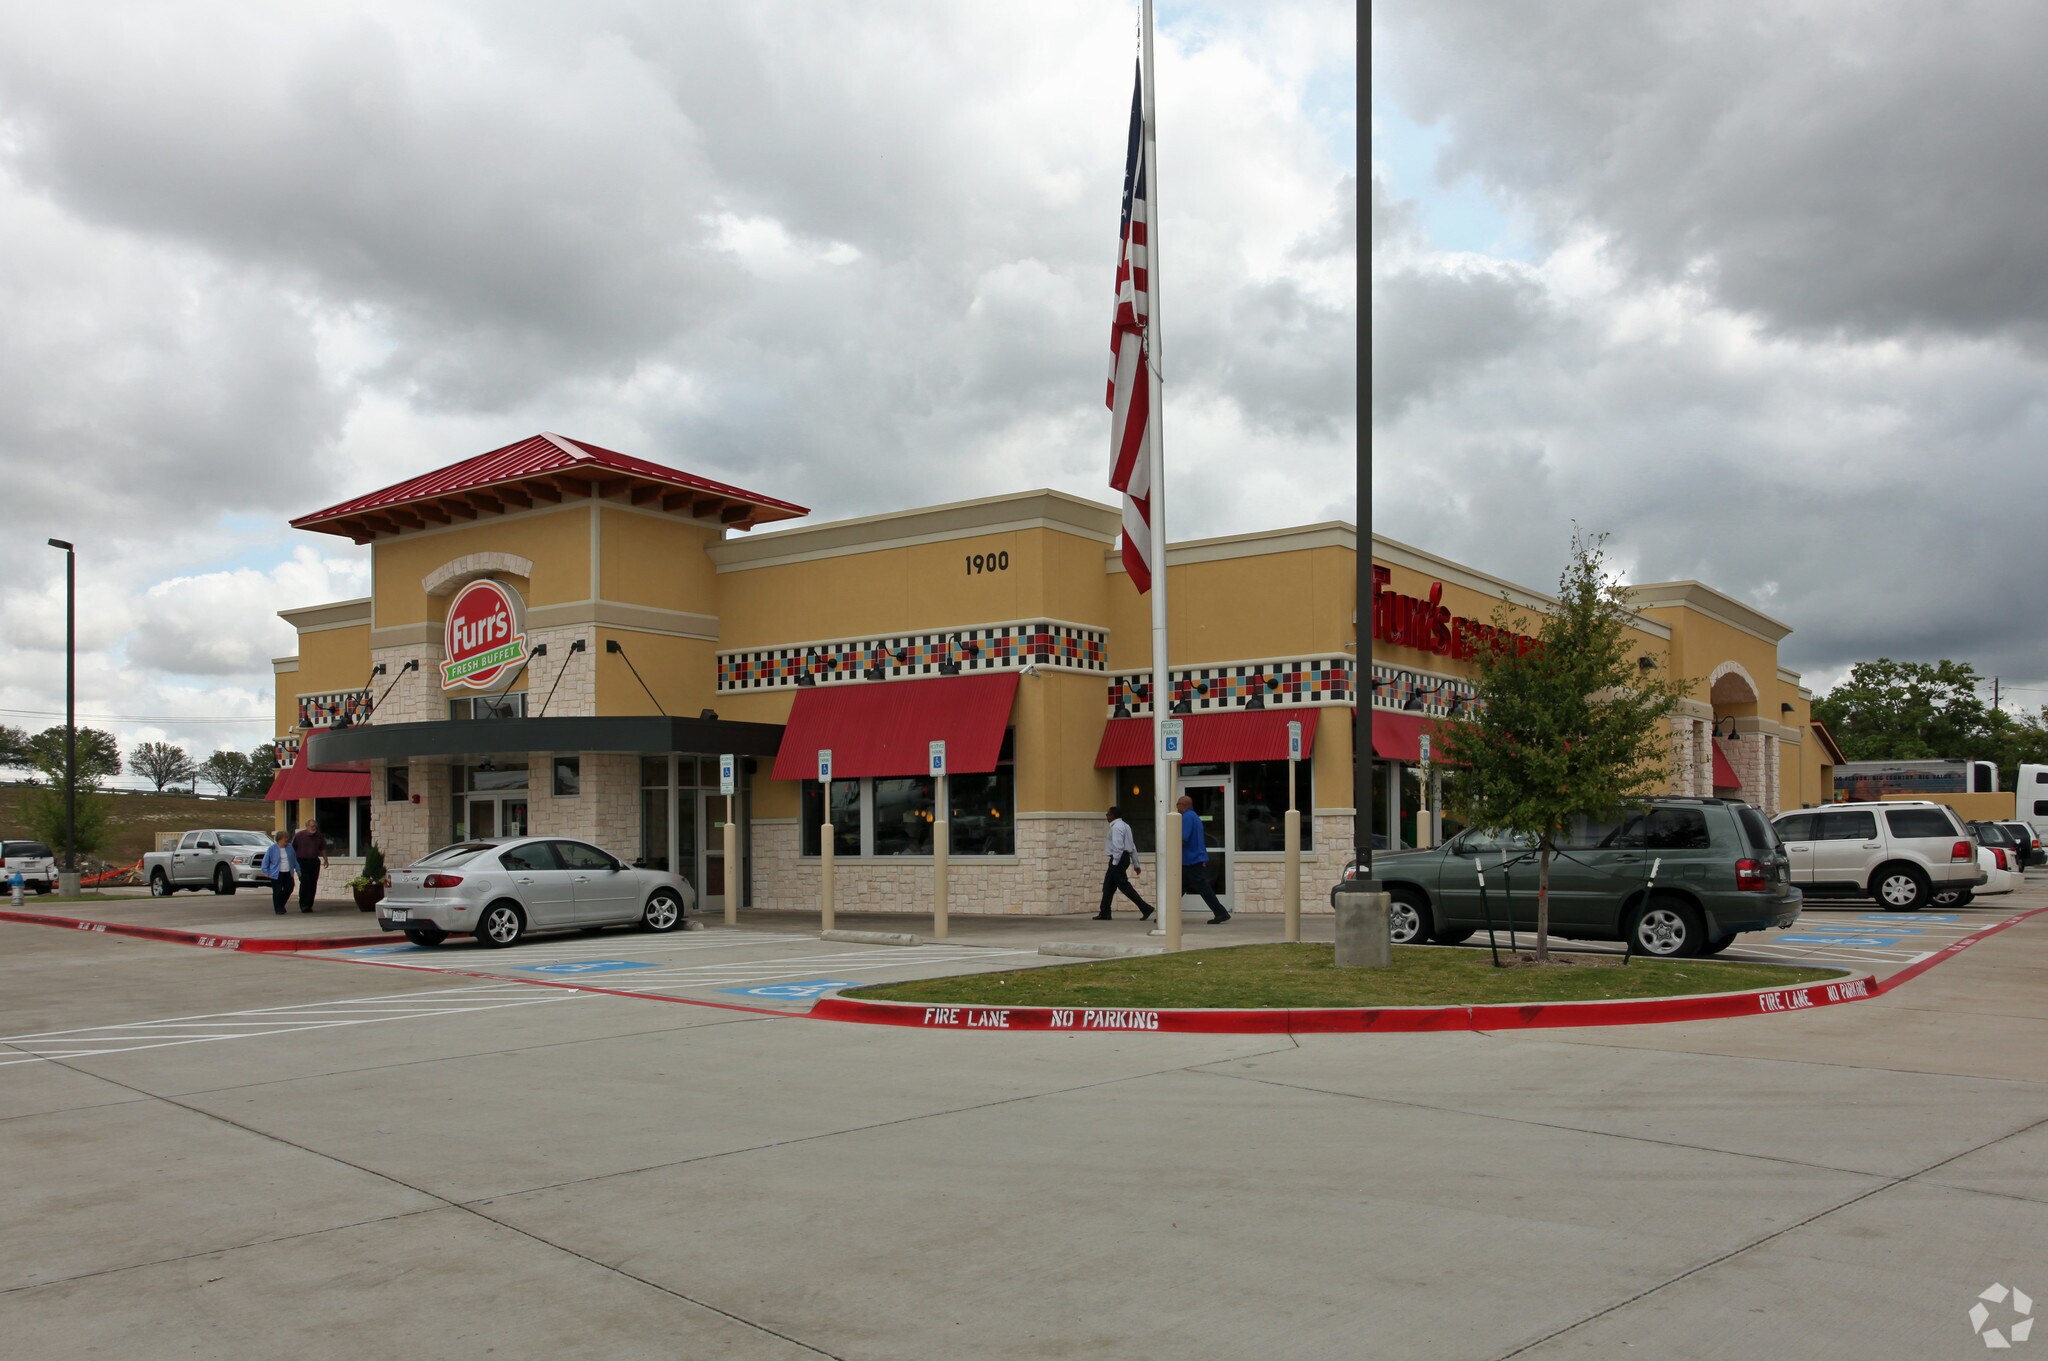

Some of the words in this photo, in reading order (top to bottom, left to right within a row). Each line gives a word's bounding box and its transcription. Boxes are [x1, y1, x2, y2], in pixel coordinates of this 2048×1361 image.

[966, 551, 1009, 576] 1900
[453, 602, 508, 654] Furr's
[452, 661, 478, 677] FRESH
[481, 646, 515, 666] BUFFET
[1759, 992, 1784, 1011] FIRE
[1785, 989, 1814, 1009] LANE
[1826, 985, 1840, 1002] NO
[1839, 980, 1869, 999] PARKING
[924, 1008, 960, 1025] FIRE
[967, 1010, 1010, 1028] LANE
[1050, 1010, 1074, 1027] NO
[1083, 1010, 1159, 1030] PARKING
